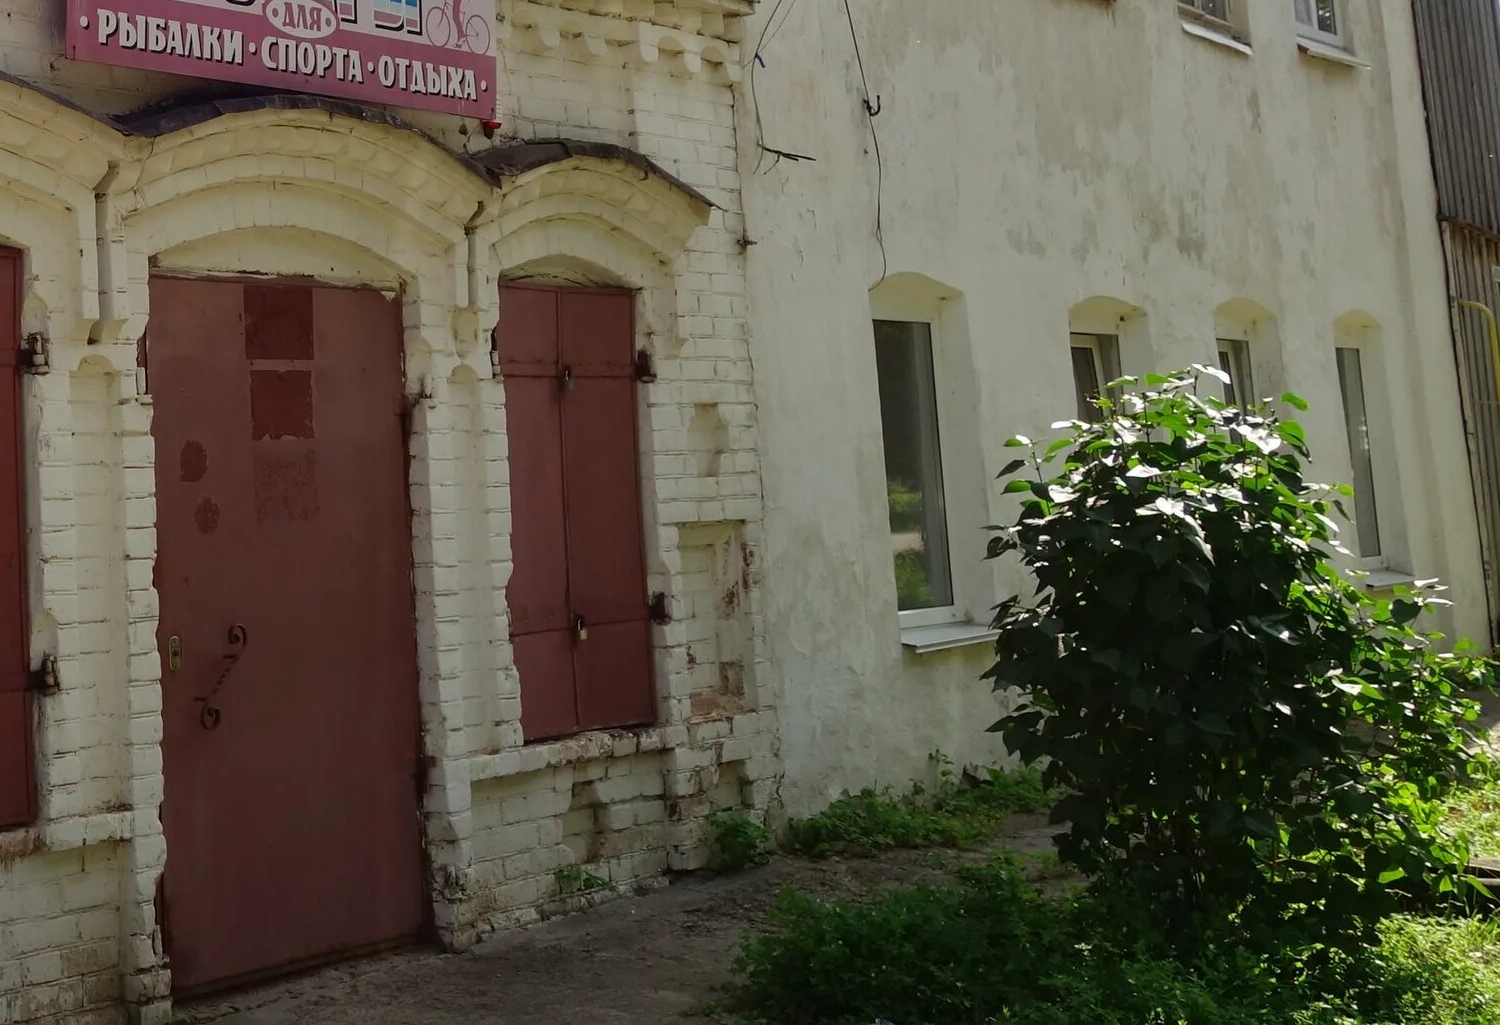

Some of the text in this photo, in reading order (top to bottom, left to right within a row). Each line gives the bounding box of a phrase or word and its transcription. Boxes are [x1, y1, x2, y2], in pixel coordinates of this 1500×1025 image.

[281, 1, 323, 33] ДЛЯ
[97, 7, 479, 102] РЫБАЛКИ СПОРТА ОТДЫХА
